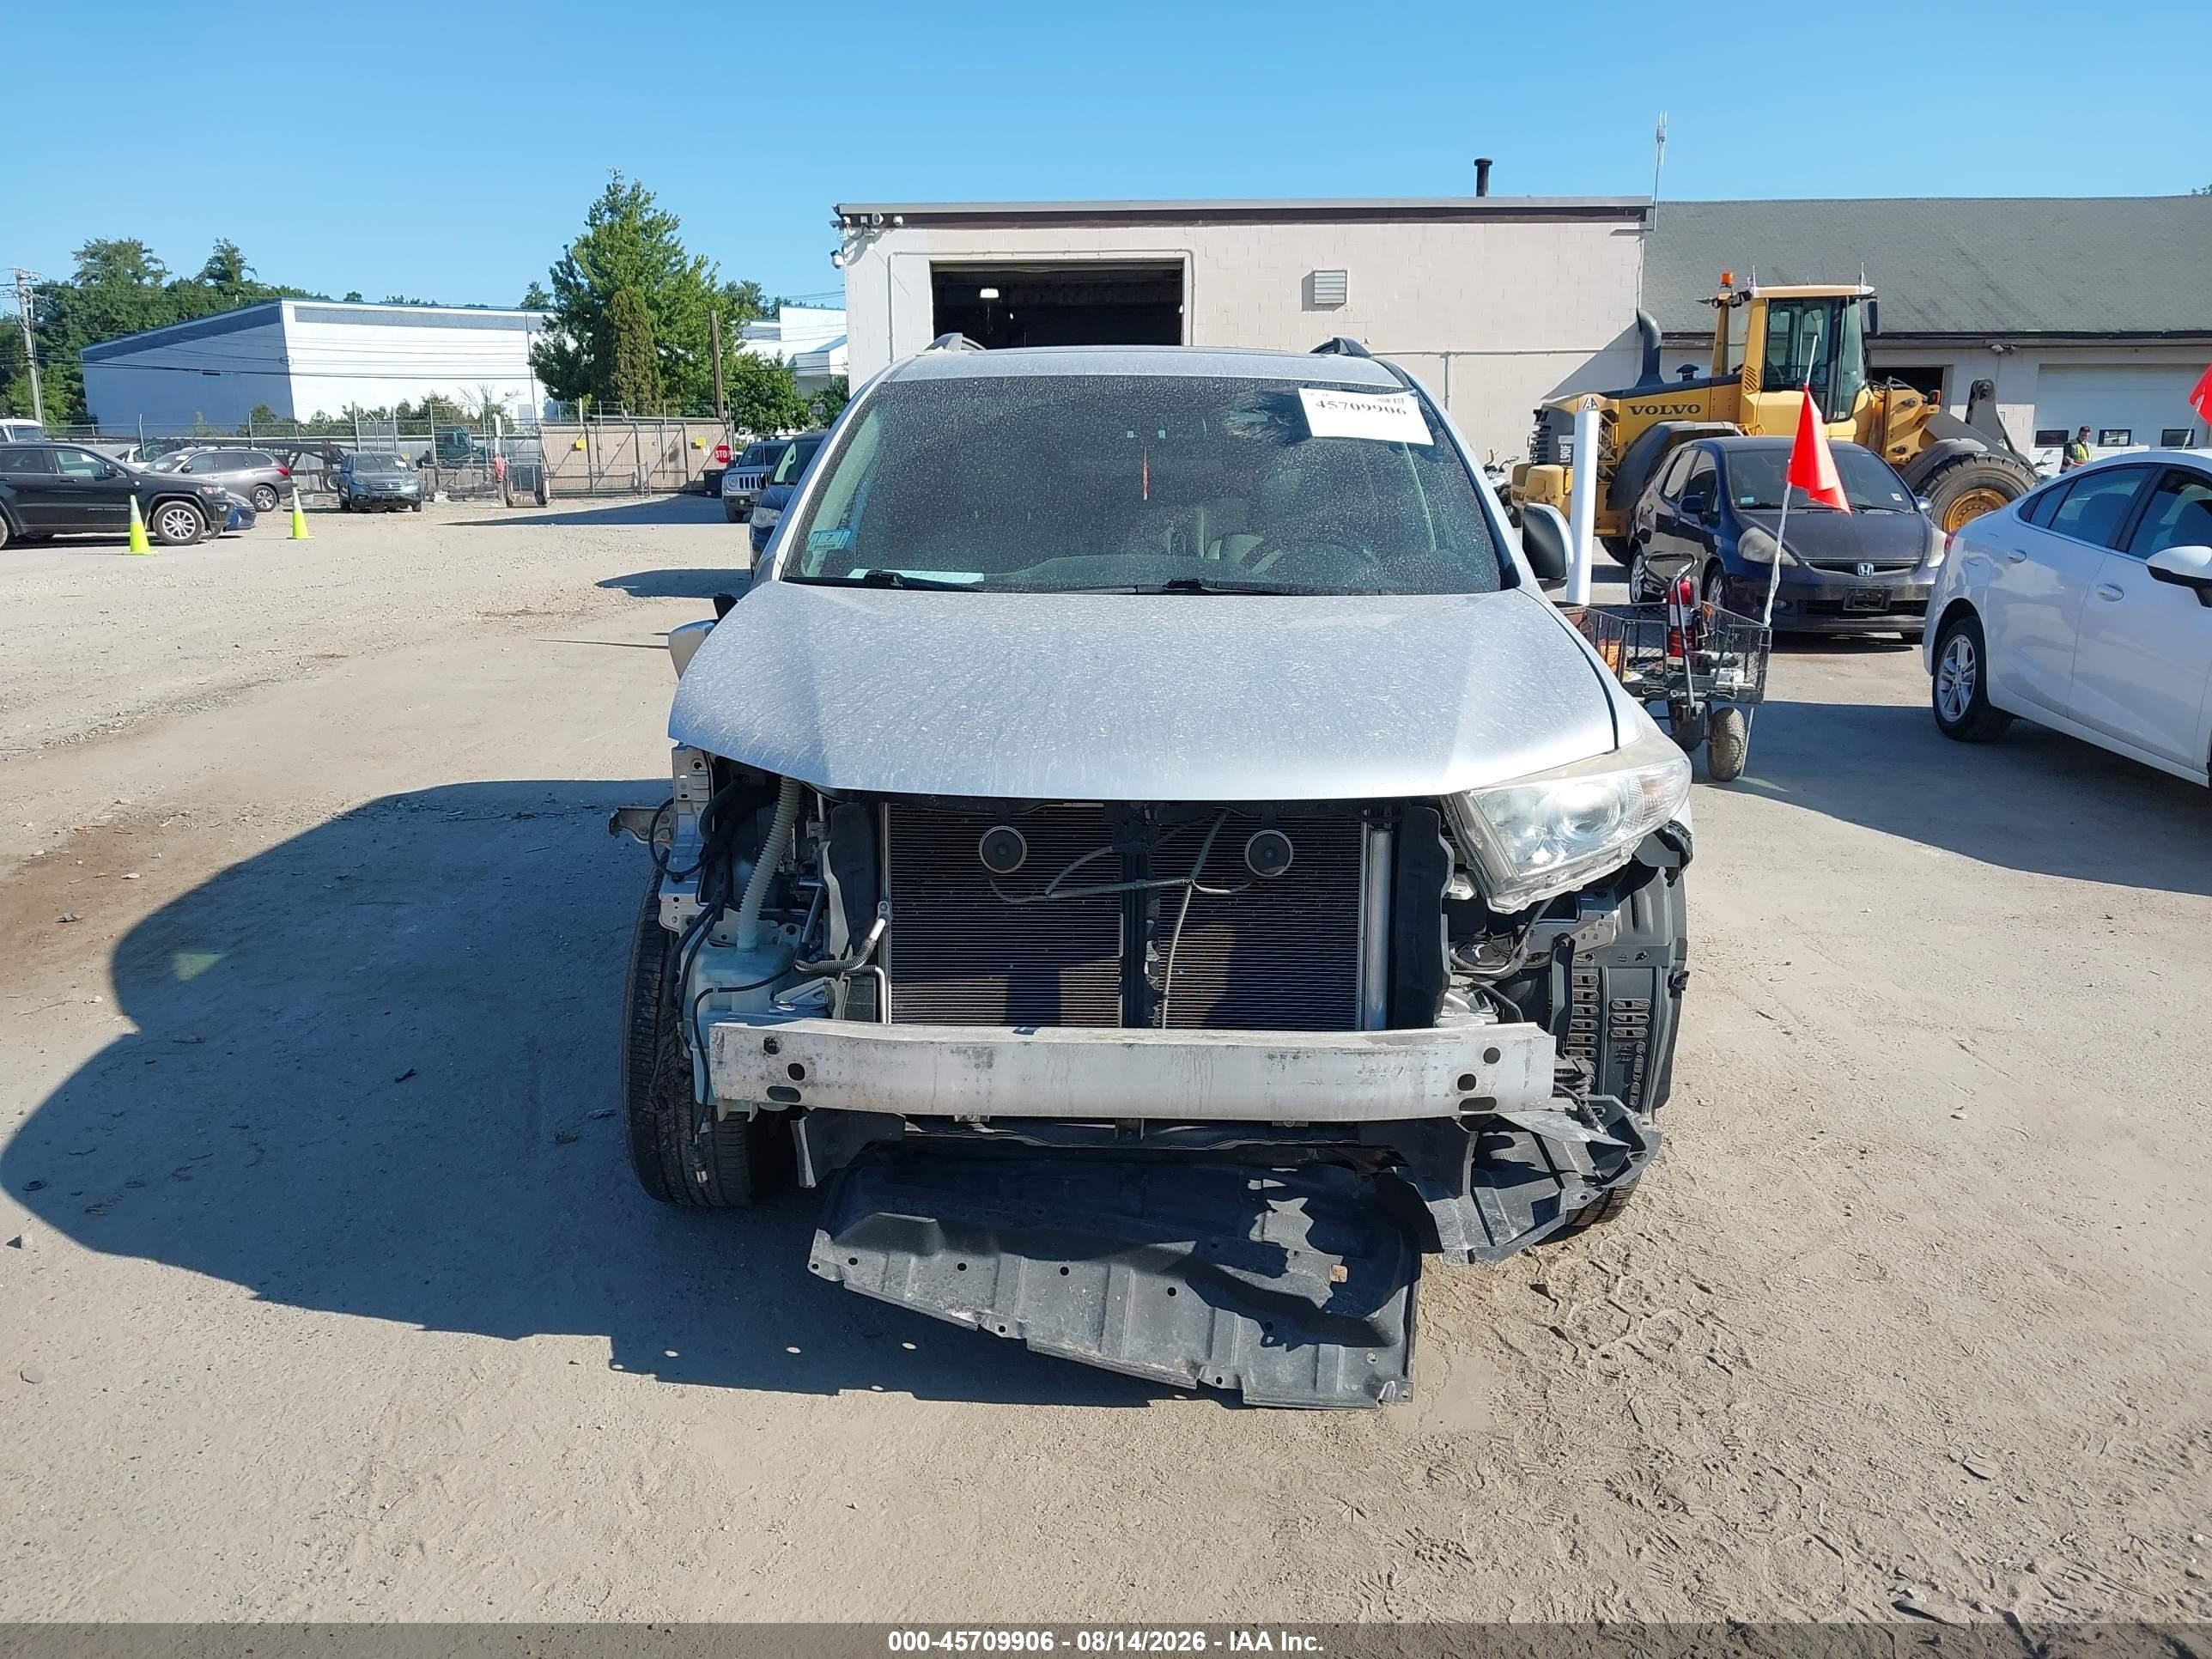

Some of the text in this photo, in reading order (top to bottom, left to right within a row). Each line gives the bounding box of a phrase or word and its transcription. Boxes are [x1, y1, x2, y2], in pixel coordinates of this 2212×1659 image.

[1315, 400, 1407, 416] 45709906
[1628, 404, 1701, 416] VOLVO
[1559, 444, 1572, 464] L90F
